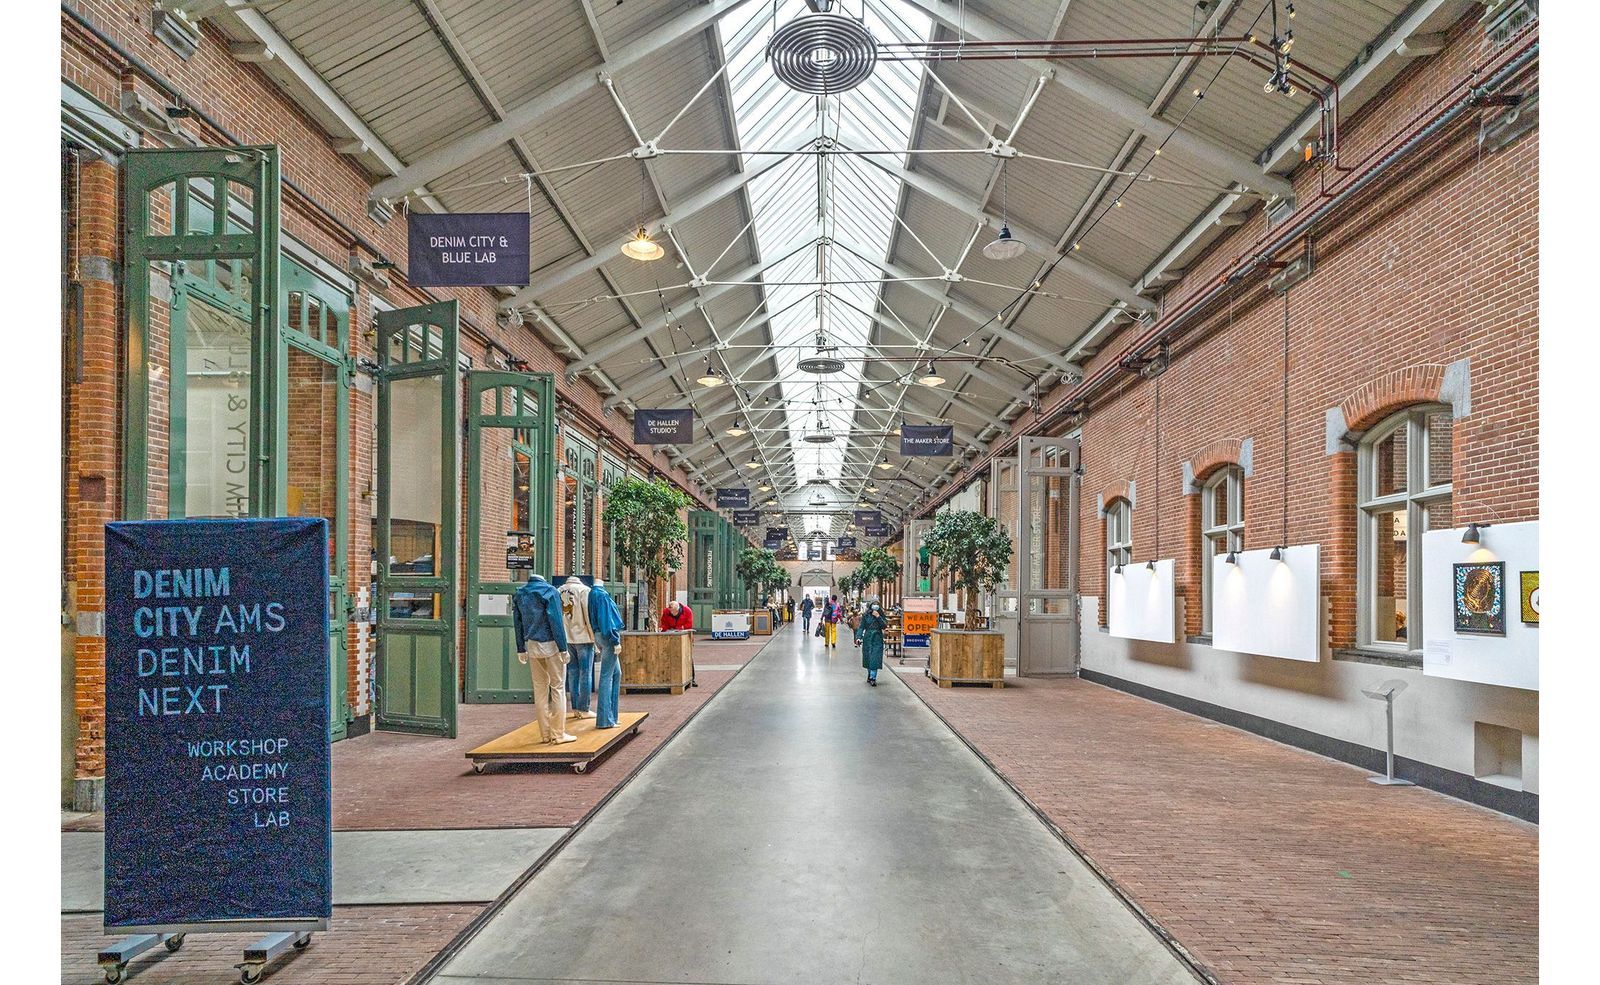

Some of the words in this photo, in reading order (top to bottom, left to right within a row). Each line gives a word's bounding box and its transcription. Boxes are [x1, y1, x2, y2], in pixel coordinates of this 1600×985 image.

[430, 236, 466, 248] DENIM
[469, 236, 495, 248] CITY
[499, 236, 509, 248] &
[442, 252, 471, 263] BLUE
[475, 252, 497, 263] LAB
[133, 567, 230, 600] DENIM
[133, 605, 203, 638] CITY
[214, 602, 286, 634] AMS
[137, 644, 251, 678] DENIM
[138, 684, 229, 716] NEXT
[187, 737, 289, 758] WORKSHOP
[201, 762, 289, 782] ACADEMY
[227, 786, 289, 805] STORE
[254, 810, 290, 828] LAB
